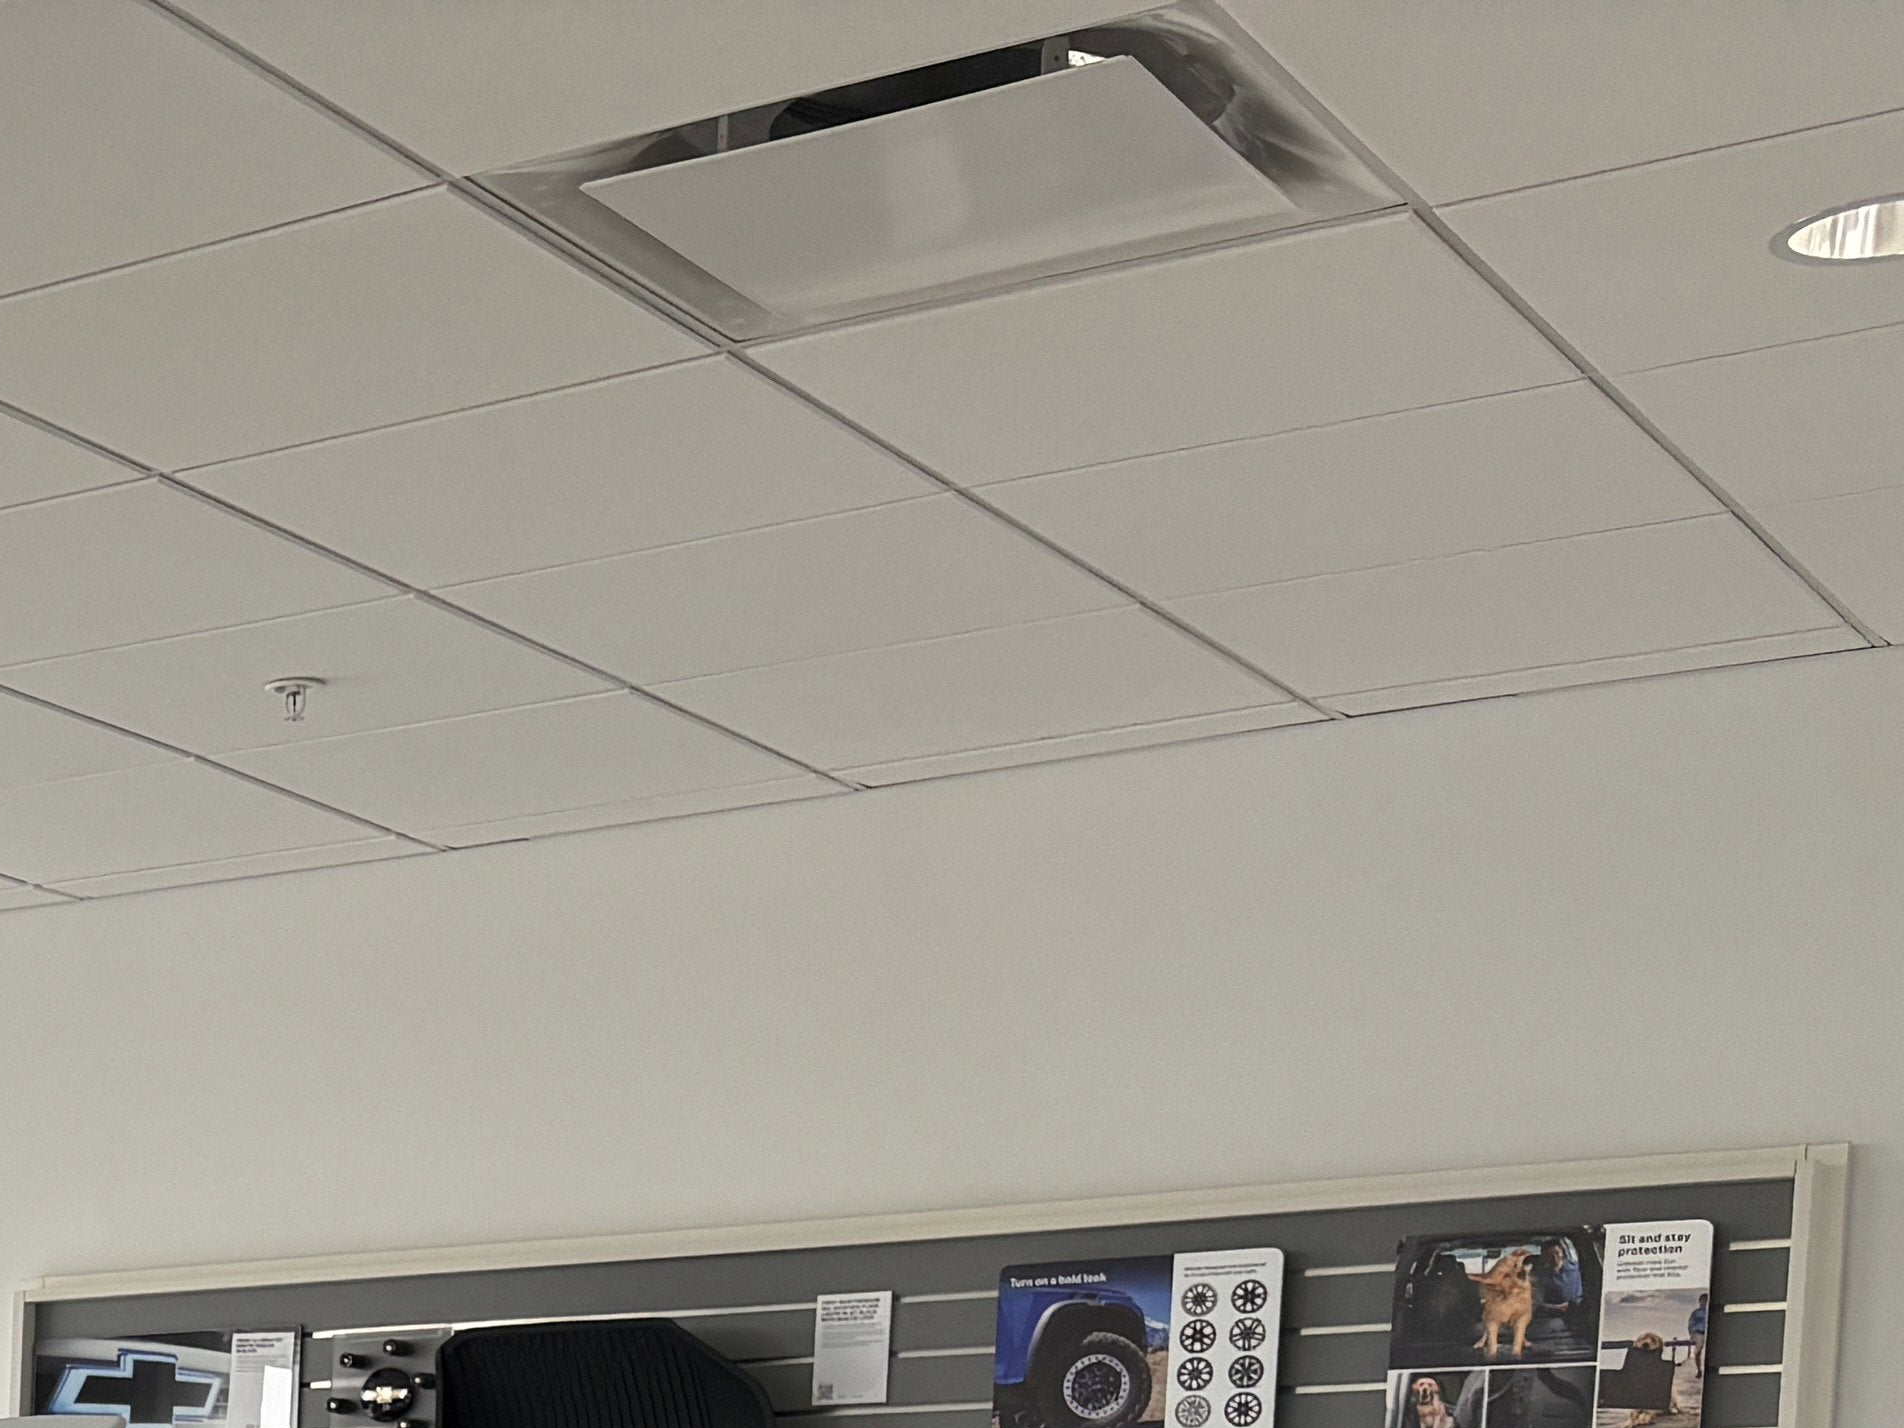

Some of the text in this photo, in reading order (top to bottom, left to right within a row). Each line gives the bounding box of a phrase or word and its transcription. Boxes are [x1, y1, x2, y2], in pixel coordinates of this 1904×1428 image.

[1619, 1233, 1692, 1244] Sit and stay
[1618, 1245, 1683, 1258] protection
[1010, 1277, 1033, 1288] Turn
[1035, 1277, 1049, 1287] on
[1050, 1277, 1057, 1286] a
[1058, 1274, 1082, 1285] bold
